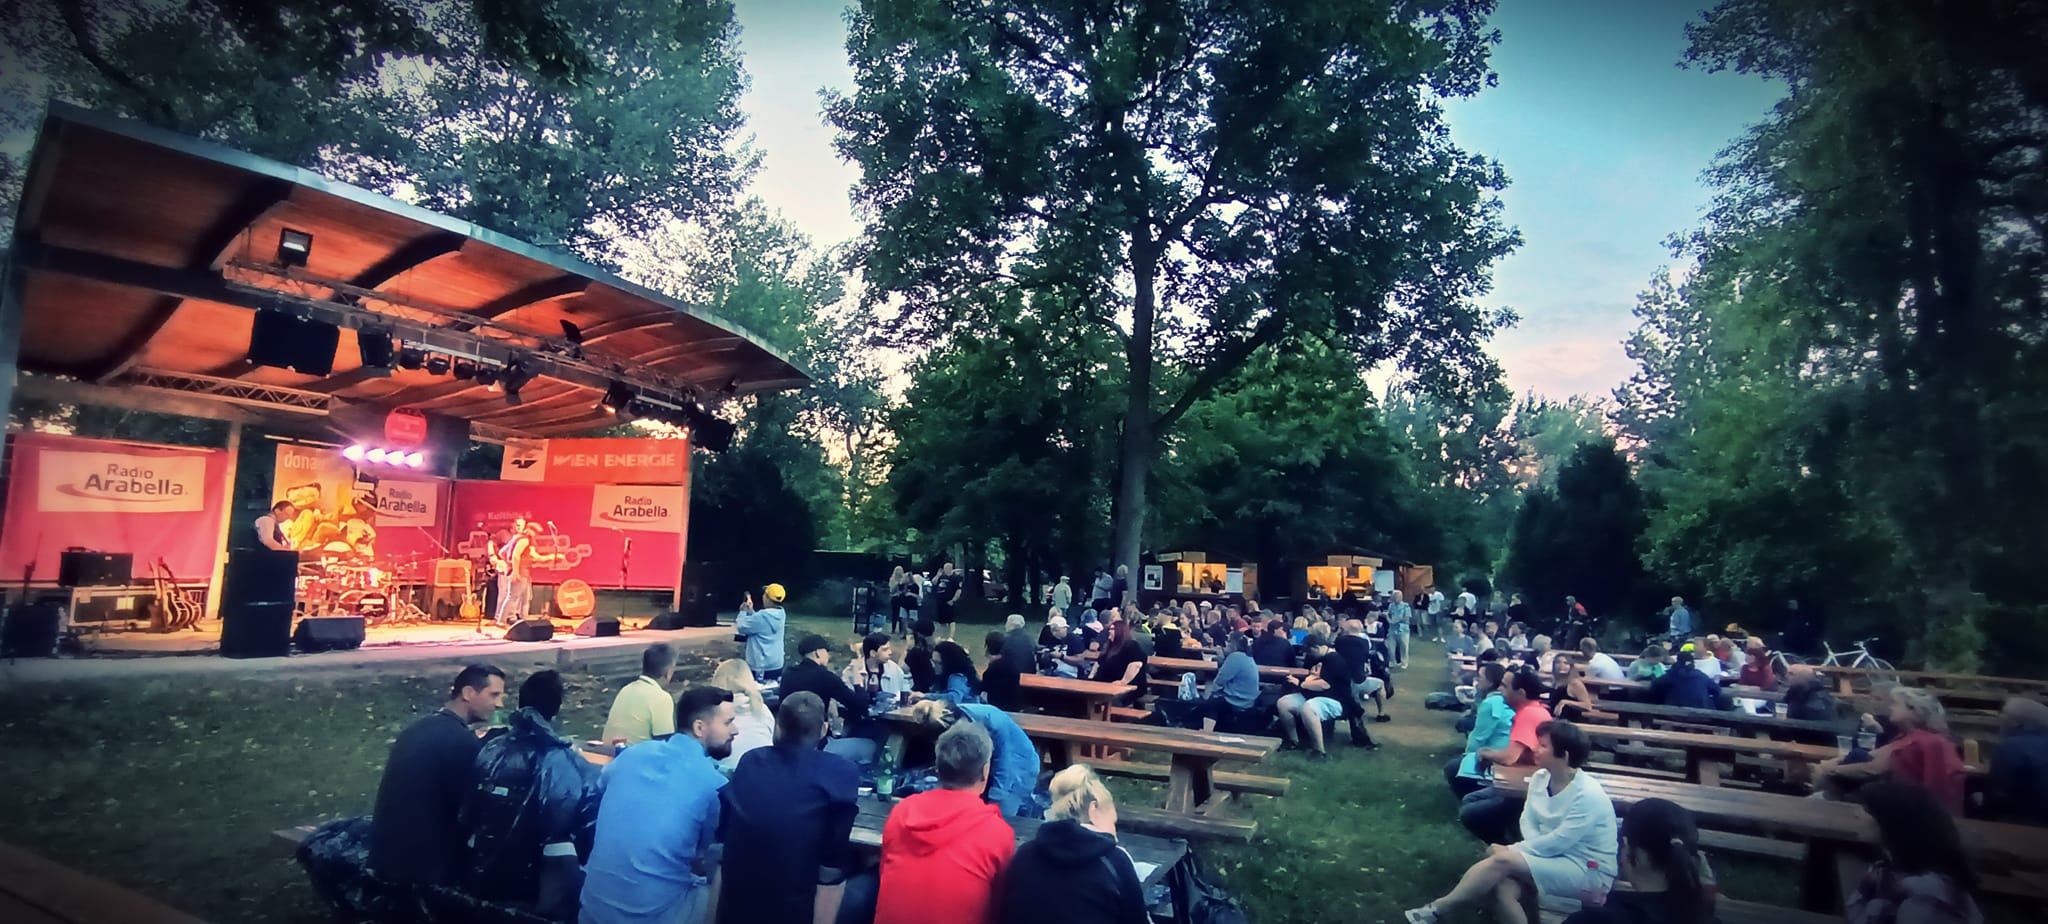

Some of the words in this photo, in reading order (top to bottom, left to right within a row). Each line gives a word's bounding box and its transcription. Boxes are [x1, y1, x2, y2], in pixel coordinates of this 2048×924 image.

[603, 454, 676, 467] ENERGIE
[107, 463, 153, 480] Radio
[84, 474, 183, 496] Arabella
[389, 488, 412, 500] Radio
[624, 495, 652, 506] Radio
[379, 497, 426, 514] Arabella
[613, 504, 668, 518] Arabella
